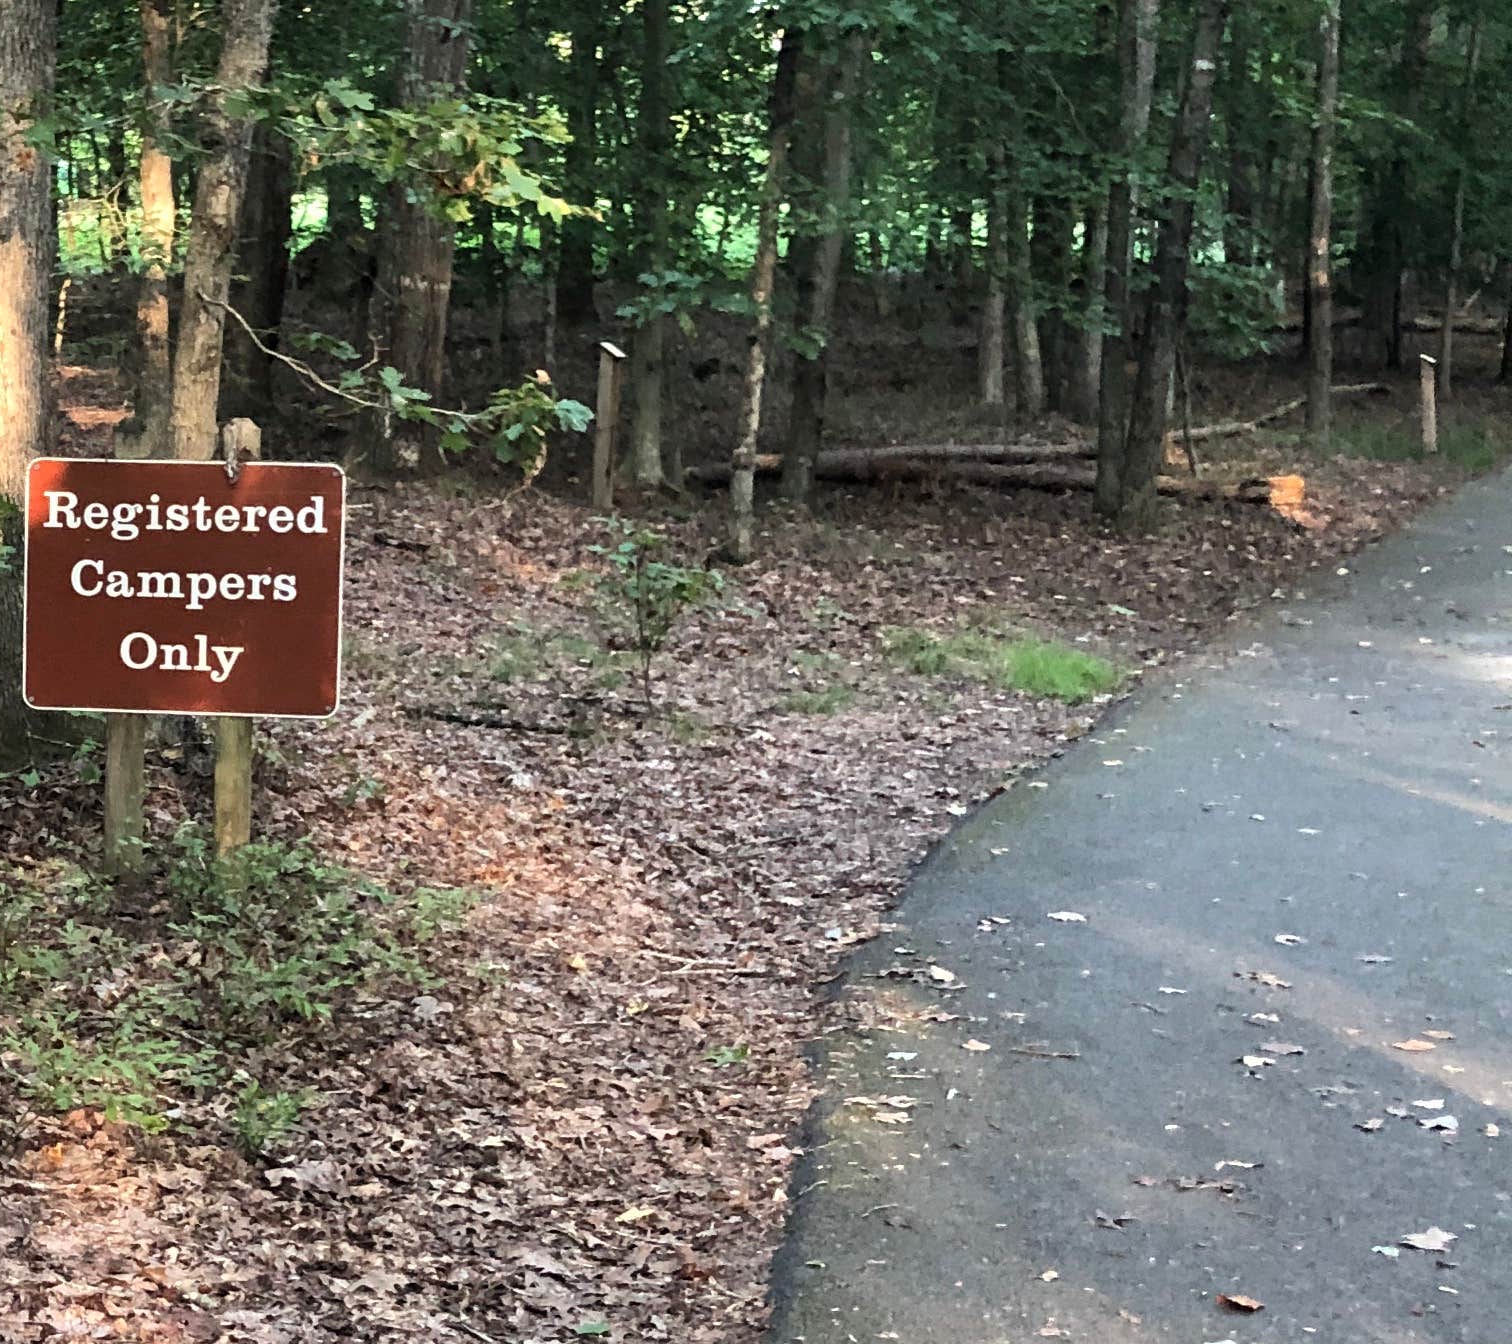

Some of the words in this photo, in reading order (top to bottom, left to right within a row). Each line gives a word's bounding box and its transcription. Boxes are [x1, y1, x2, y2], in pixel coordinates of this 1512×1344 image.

[42, 490, 329, 541] Registered
[70, 558, 298, 611] Campers
[119, 631, 245, 683] Only
